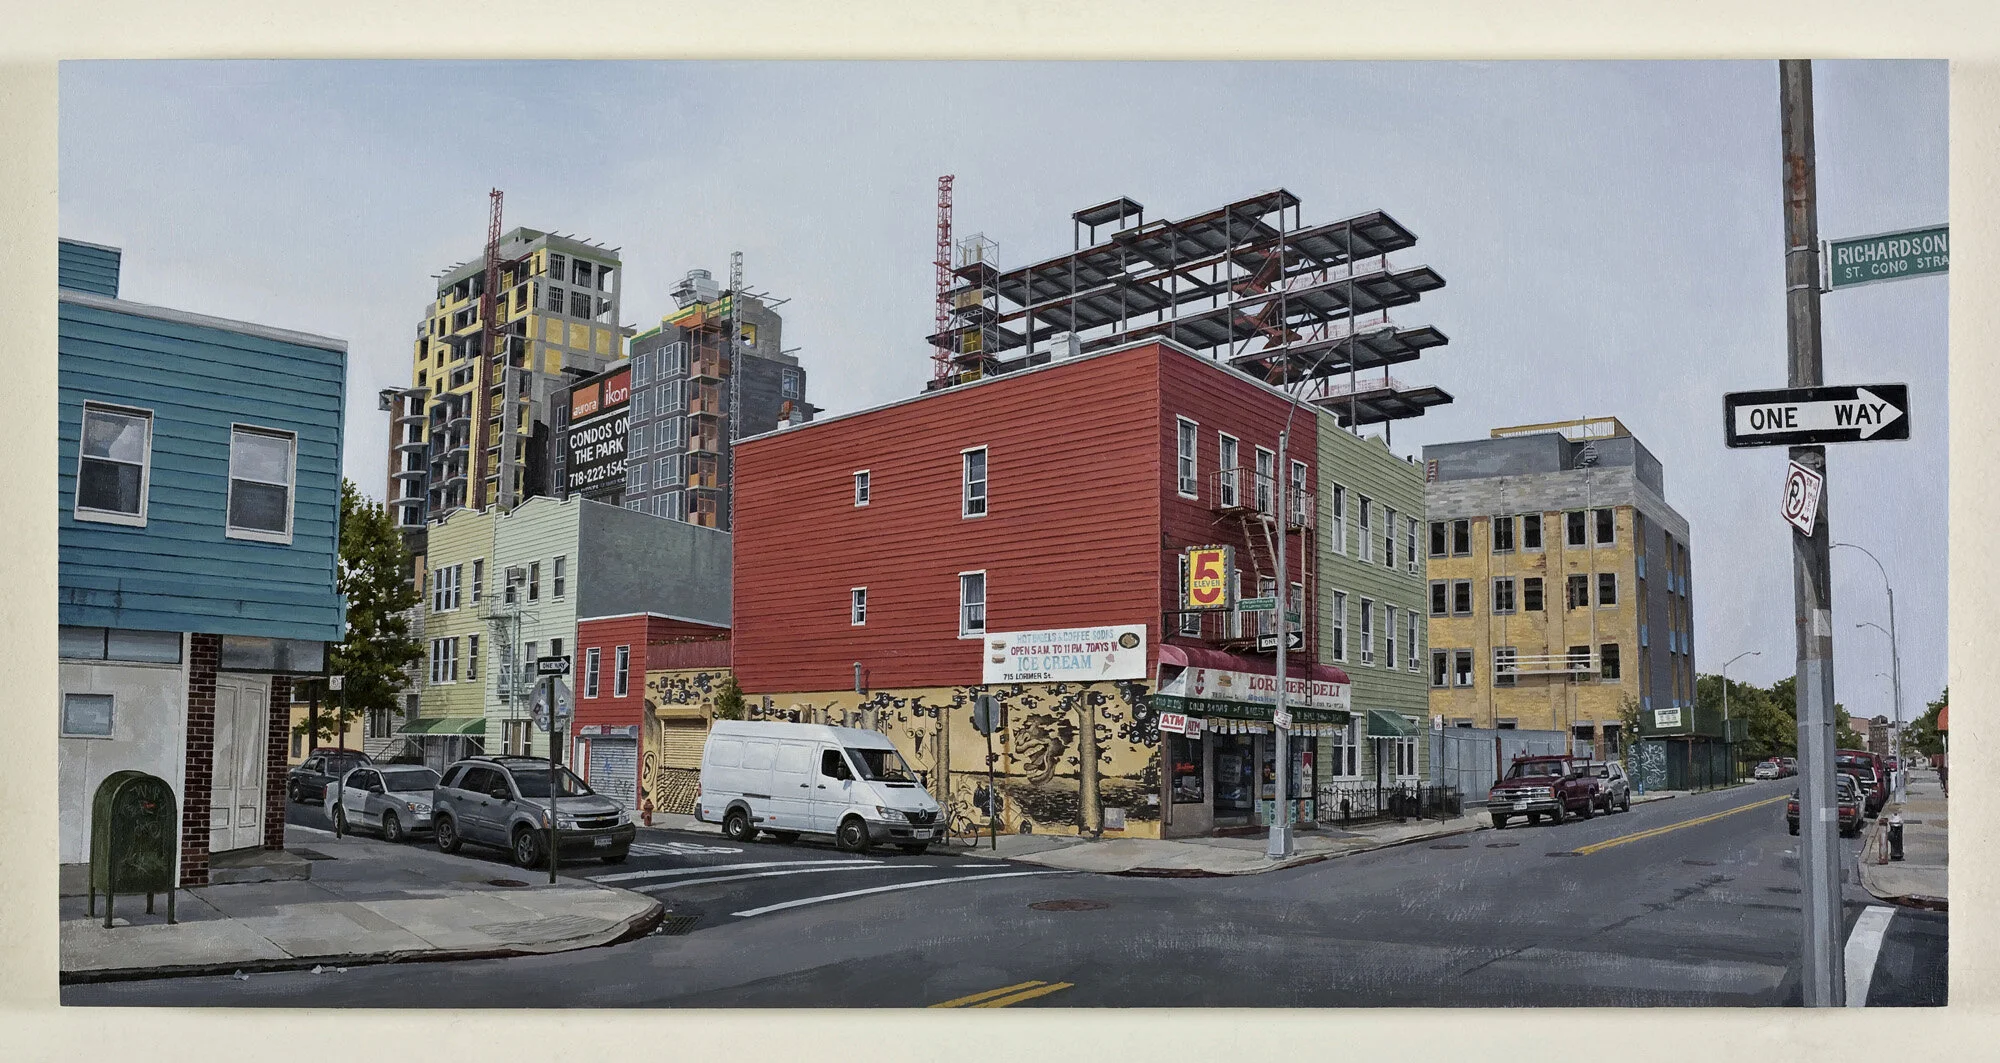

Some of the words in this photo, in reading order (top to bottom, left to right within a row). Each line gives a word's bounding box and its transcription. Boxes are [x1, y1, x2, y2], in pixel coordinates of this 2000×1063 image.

[1838, 233, 1947, 265] RICHARDSON
[1845, 266, 1863, 279] ST.
[1871, 260, 1908, 275] CONO
[605, 381, 628, 406] ikon
[1750, 406, 1798, 430] ONE
[1834, 403, 1887, 426] WAY
[570, 422, 612, 449] CONDOS
[615, 417, 630, 435] ON
[575, 446, 594, 465] THE
[596, 437, 624, 459] PARK
[1193, 552, 1221, 603] 5
[1194, 580, 1220, 588] ELEVEN
[1063, 631, 1090, 642] COFFEE
[1011, 646, 1030, 656] OPEN
[1052, 644, 1062, 654] TO
[1017, 655, 1038, 671] ICE
[1043, 654, 1092, 671] CREAM
[1313, 683, 1340, 697] DELI
[1162, 714, 1185, 727] ATM
[1187, 720, 1200, 732] ATM
